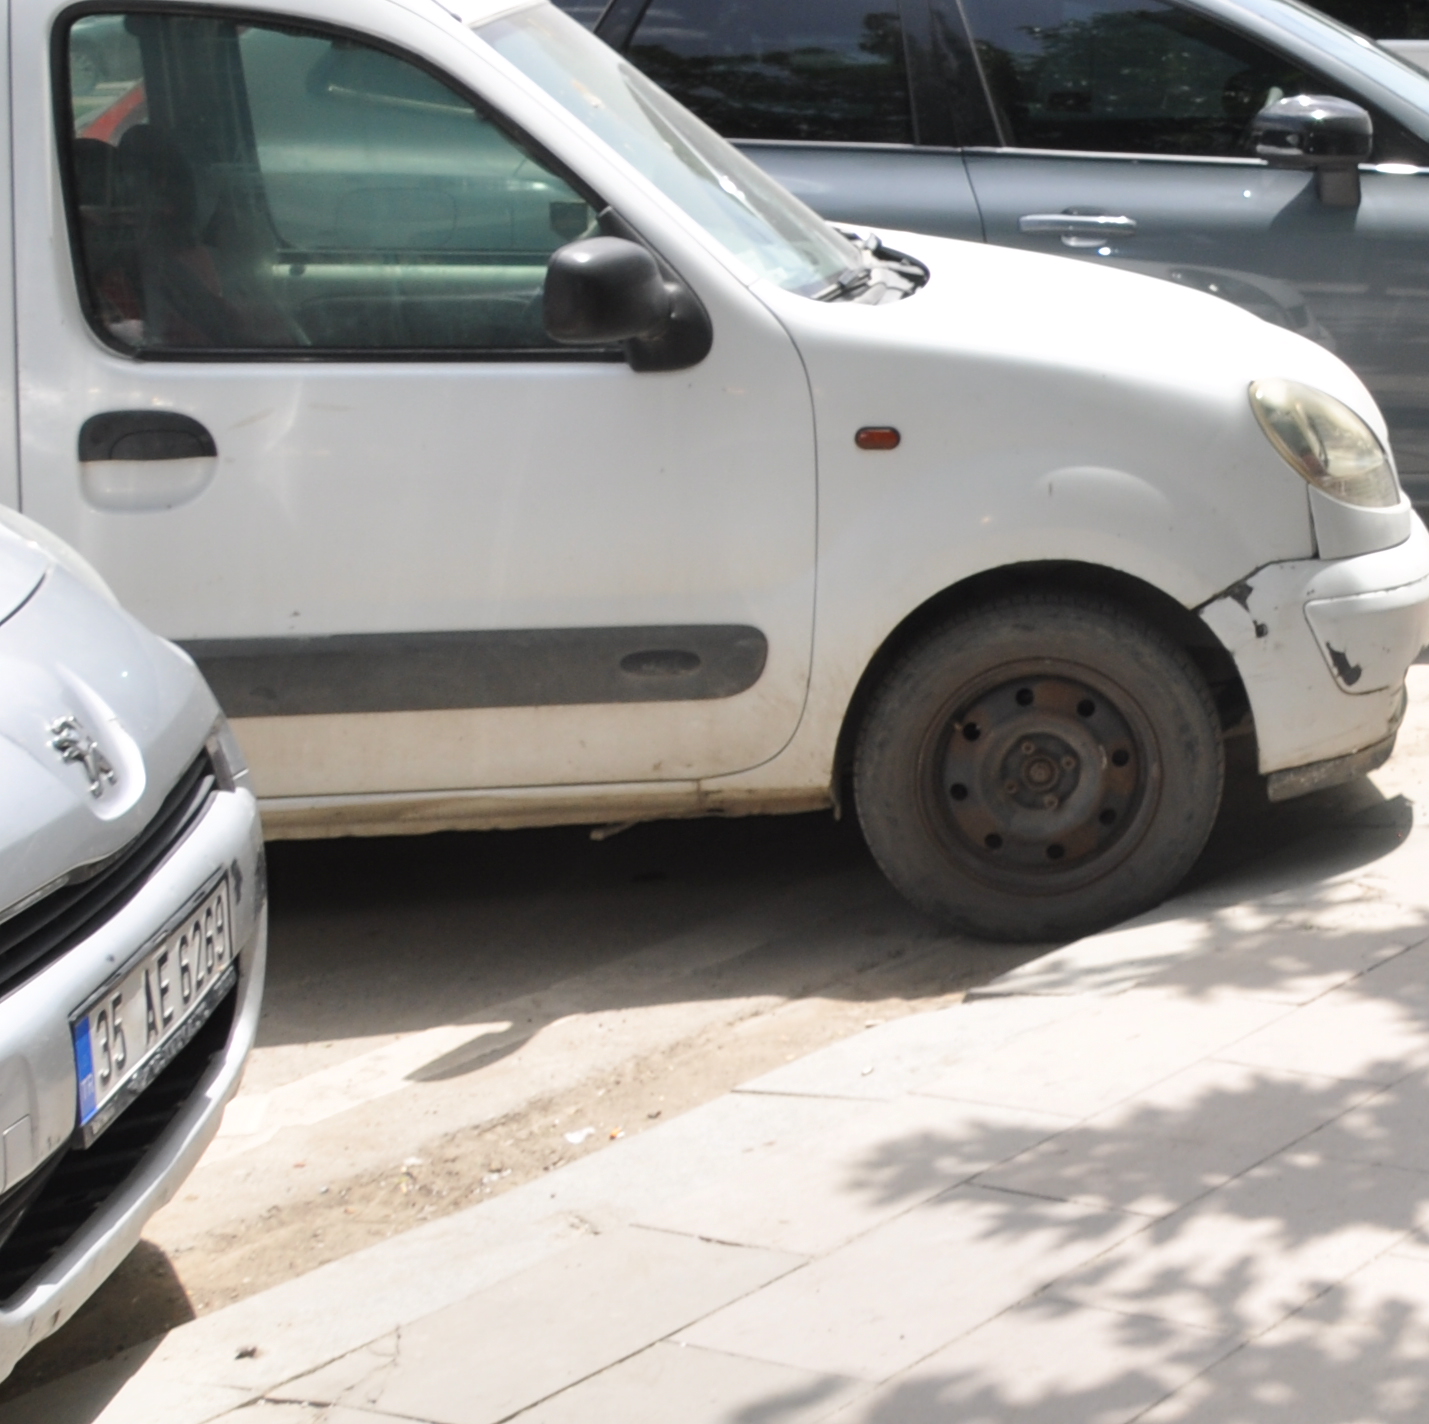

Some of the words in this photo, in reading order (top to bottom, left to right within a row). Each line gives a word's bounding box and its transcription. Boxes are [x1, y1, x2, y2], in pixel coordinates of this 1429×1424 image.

[96, 990, 126, 1086] 35
[141, 942, 175, 1047] AE
[177, 892, 226, 1006] 6269
